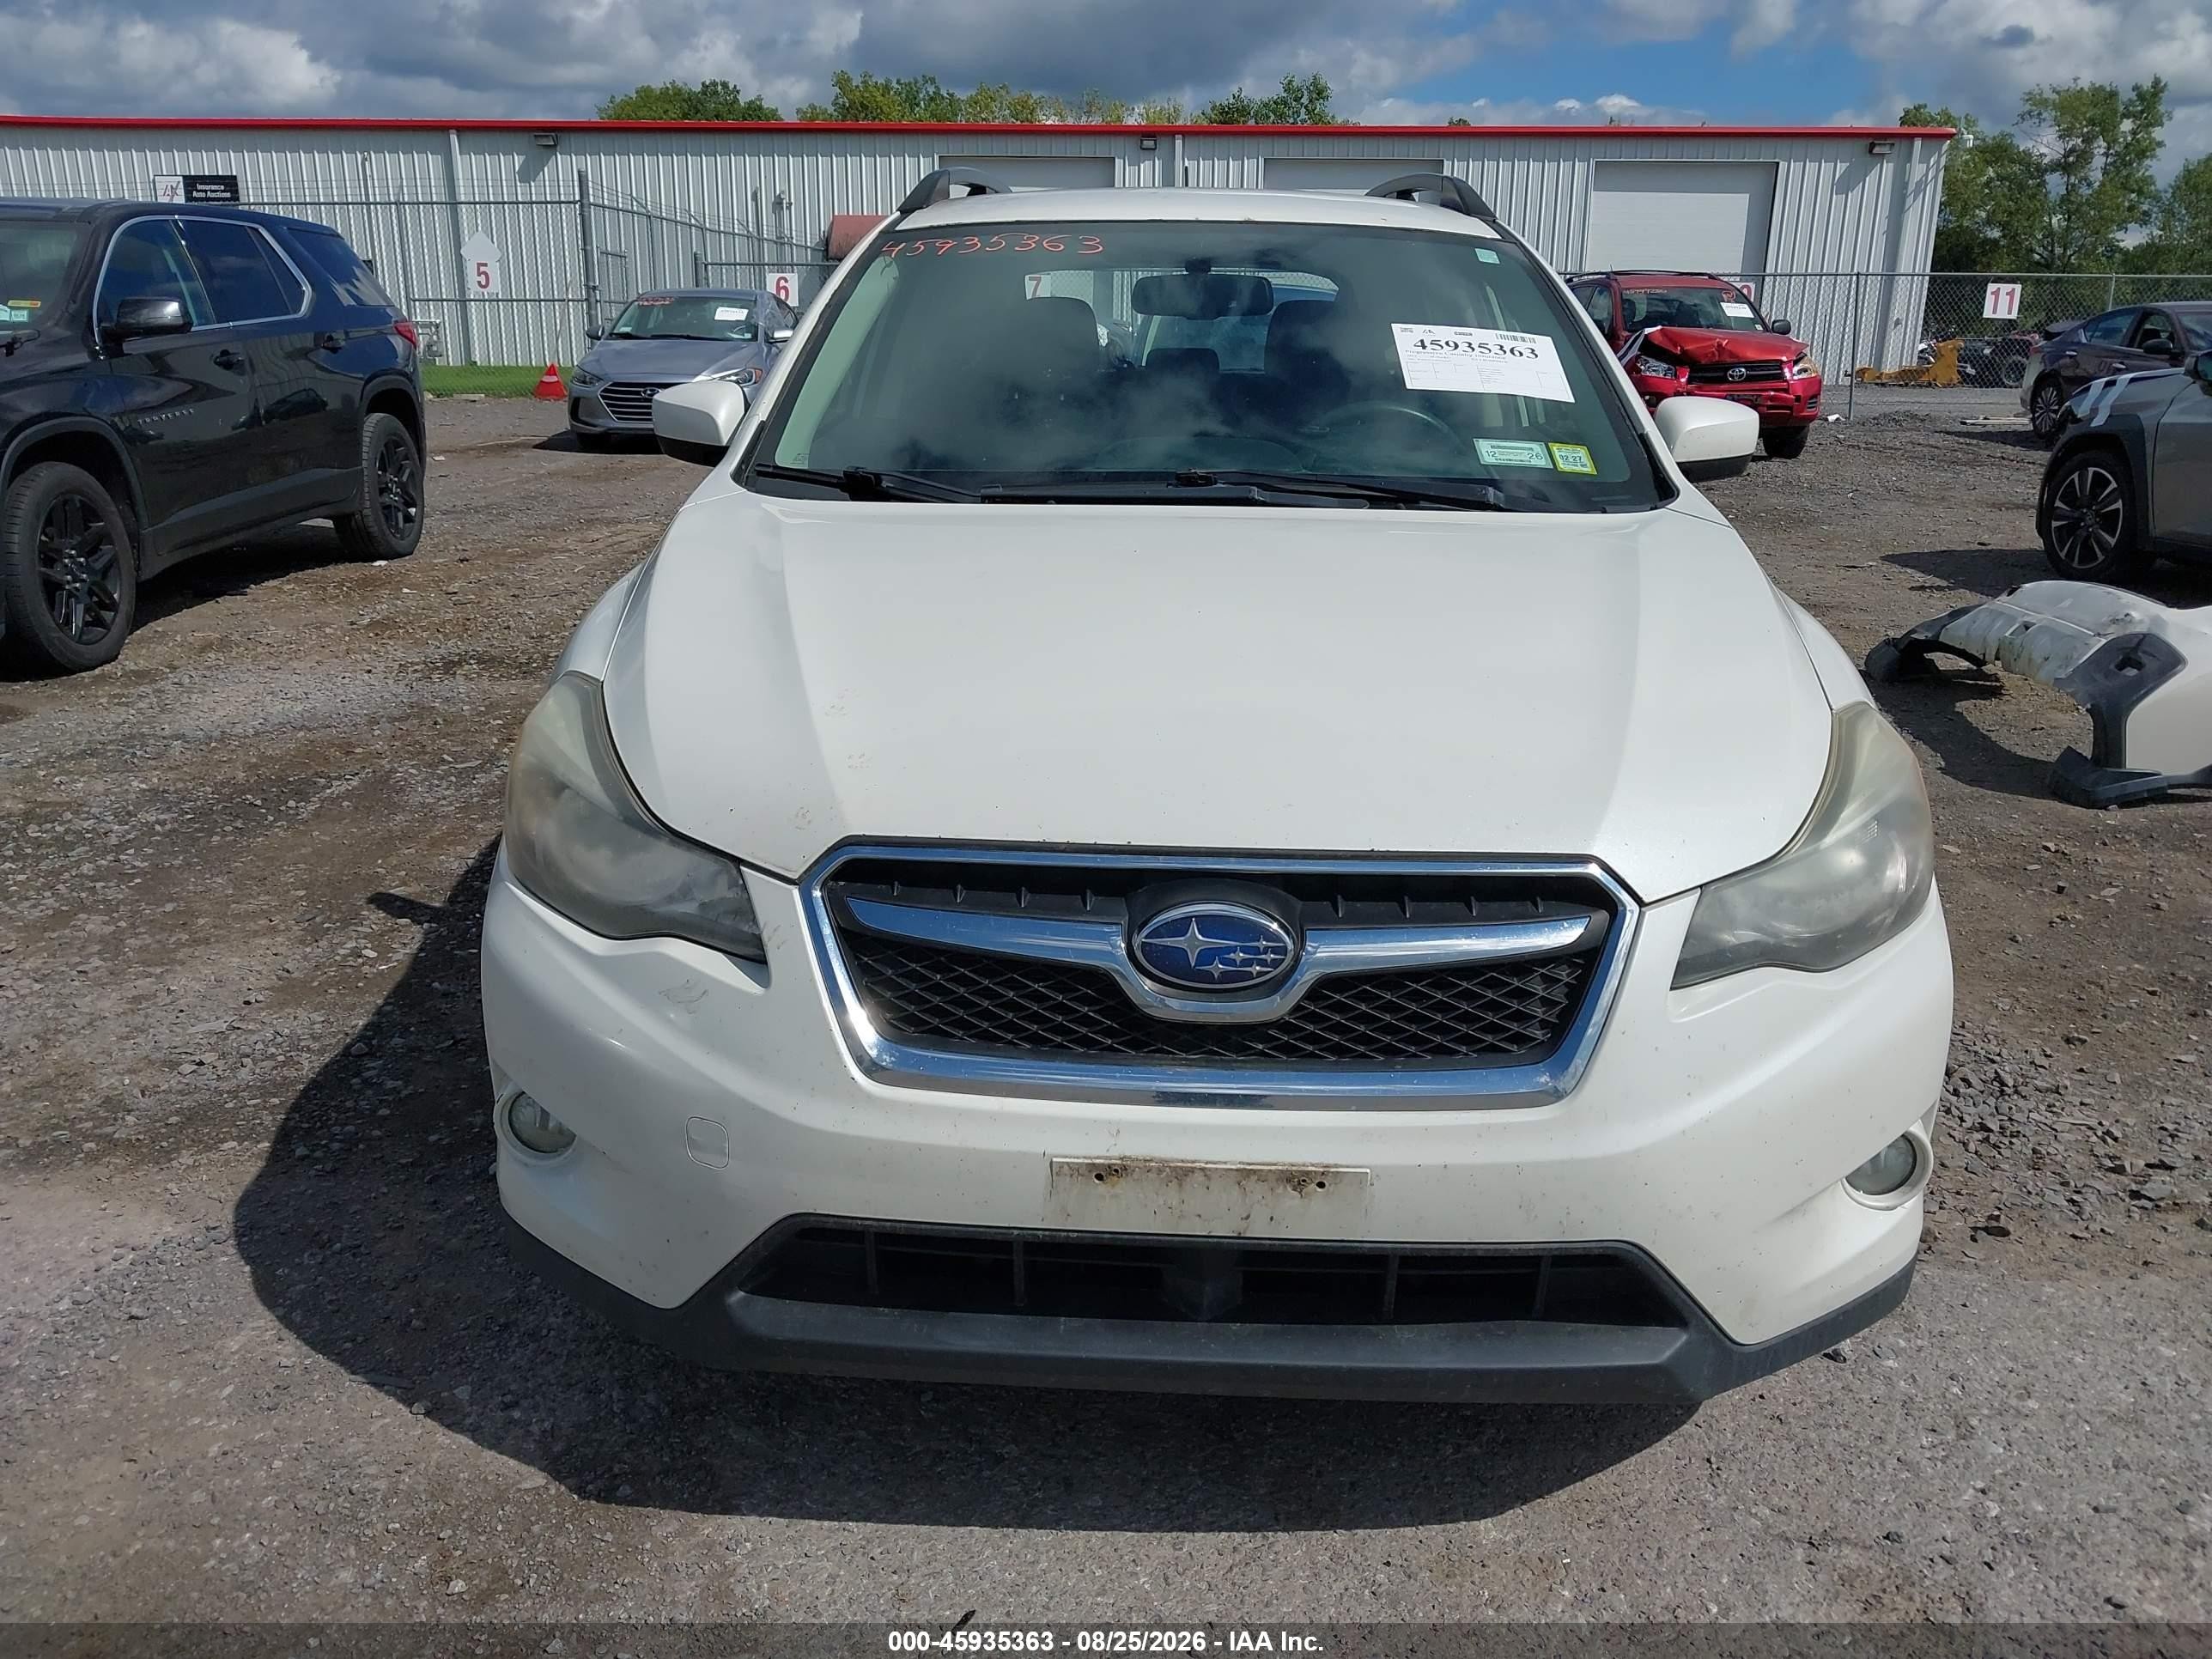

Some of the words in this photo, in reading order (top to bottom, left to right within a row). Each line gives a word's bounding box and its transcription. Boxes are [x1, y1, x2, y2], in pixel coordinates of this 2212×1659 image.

[881, 233, 1104, 258] 45935363
[477, 262, 490, 289] 5
[1028, 276, 1042, 299] 7
[775, 276, 790, 302] 6
[1990, 287, 2016, 315] 11
[1413, 338, 1539, 359] 45935363
[1527, 452, 1544, 460] 26
